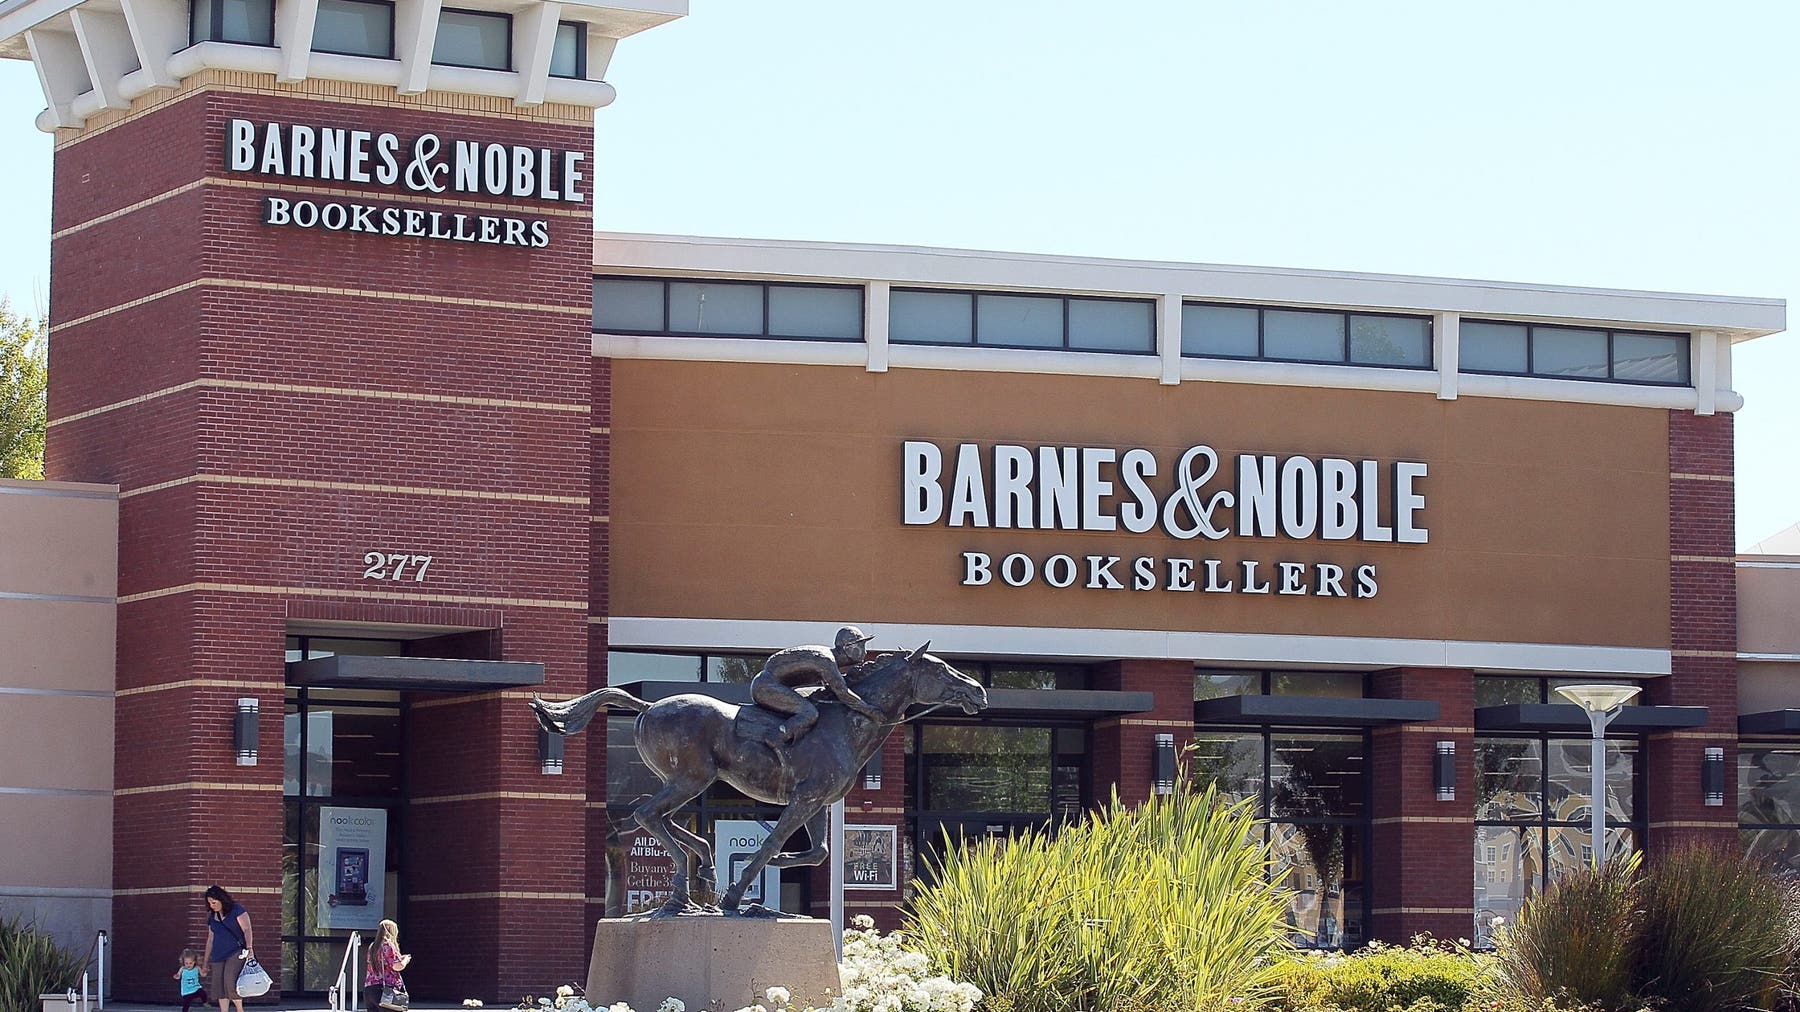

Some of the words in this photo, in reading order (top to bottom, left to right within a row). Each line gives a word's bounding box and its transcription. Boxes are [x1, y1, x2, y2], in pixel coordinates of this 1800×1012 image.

[266, 197, 551, 249] BOOKSELLERS
[363, 551, 433, 582] 277
[962, 551, 1379, 600] BOOKSELLERS
[634, 836, 647, 847] All
[729, 833, 764, 847] nook
[630, 847, 643, 857] All
[645, 847, 672, 857] Blu-ra
[630, 861, 649, 874] Buy
[651, 865, 668, 874] any
[669, 862, 676, 874] 2
[853, 862, 878, 870] FREE
[627, 874, 644, 887] Get
[646, 875, 662, 887] the
